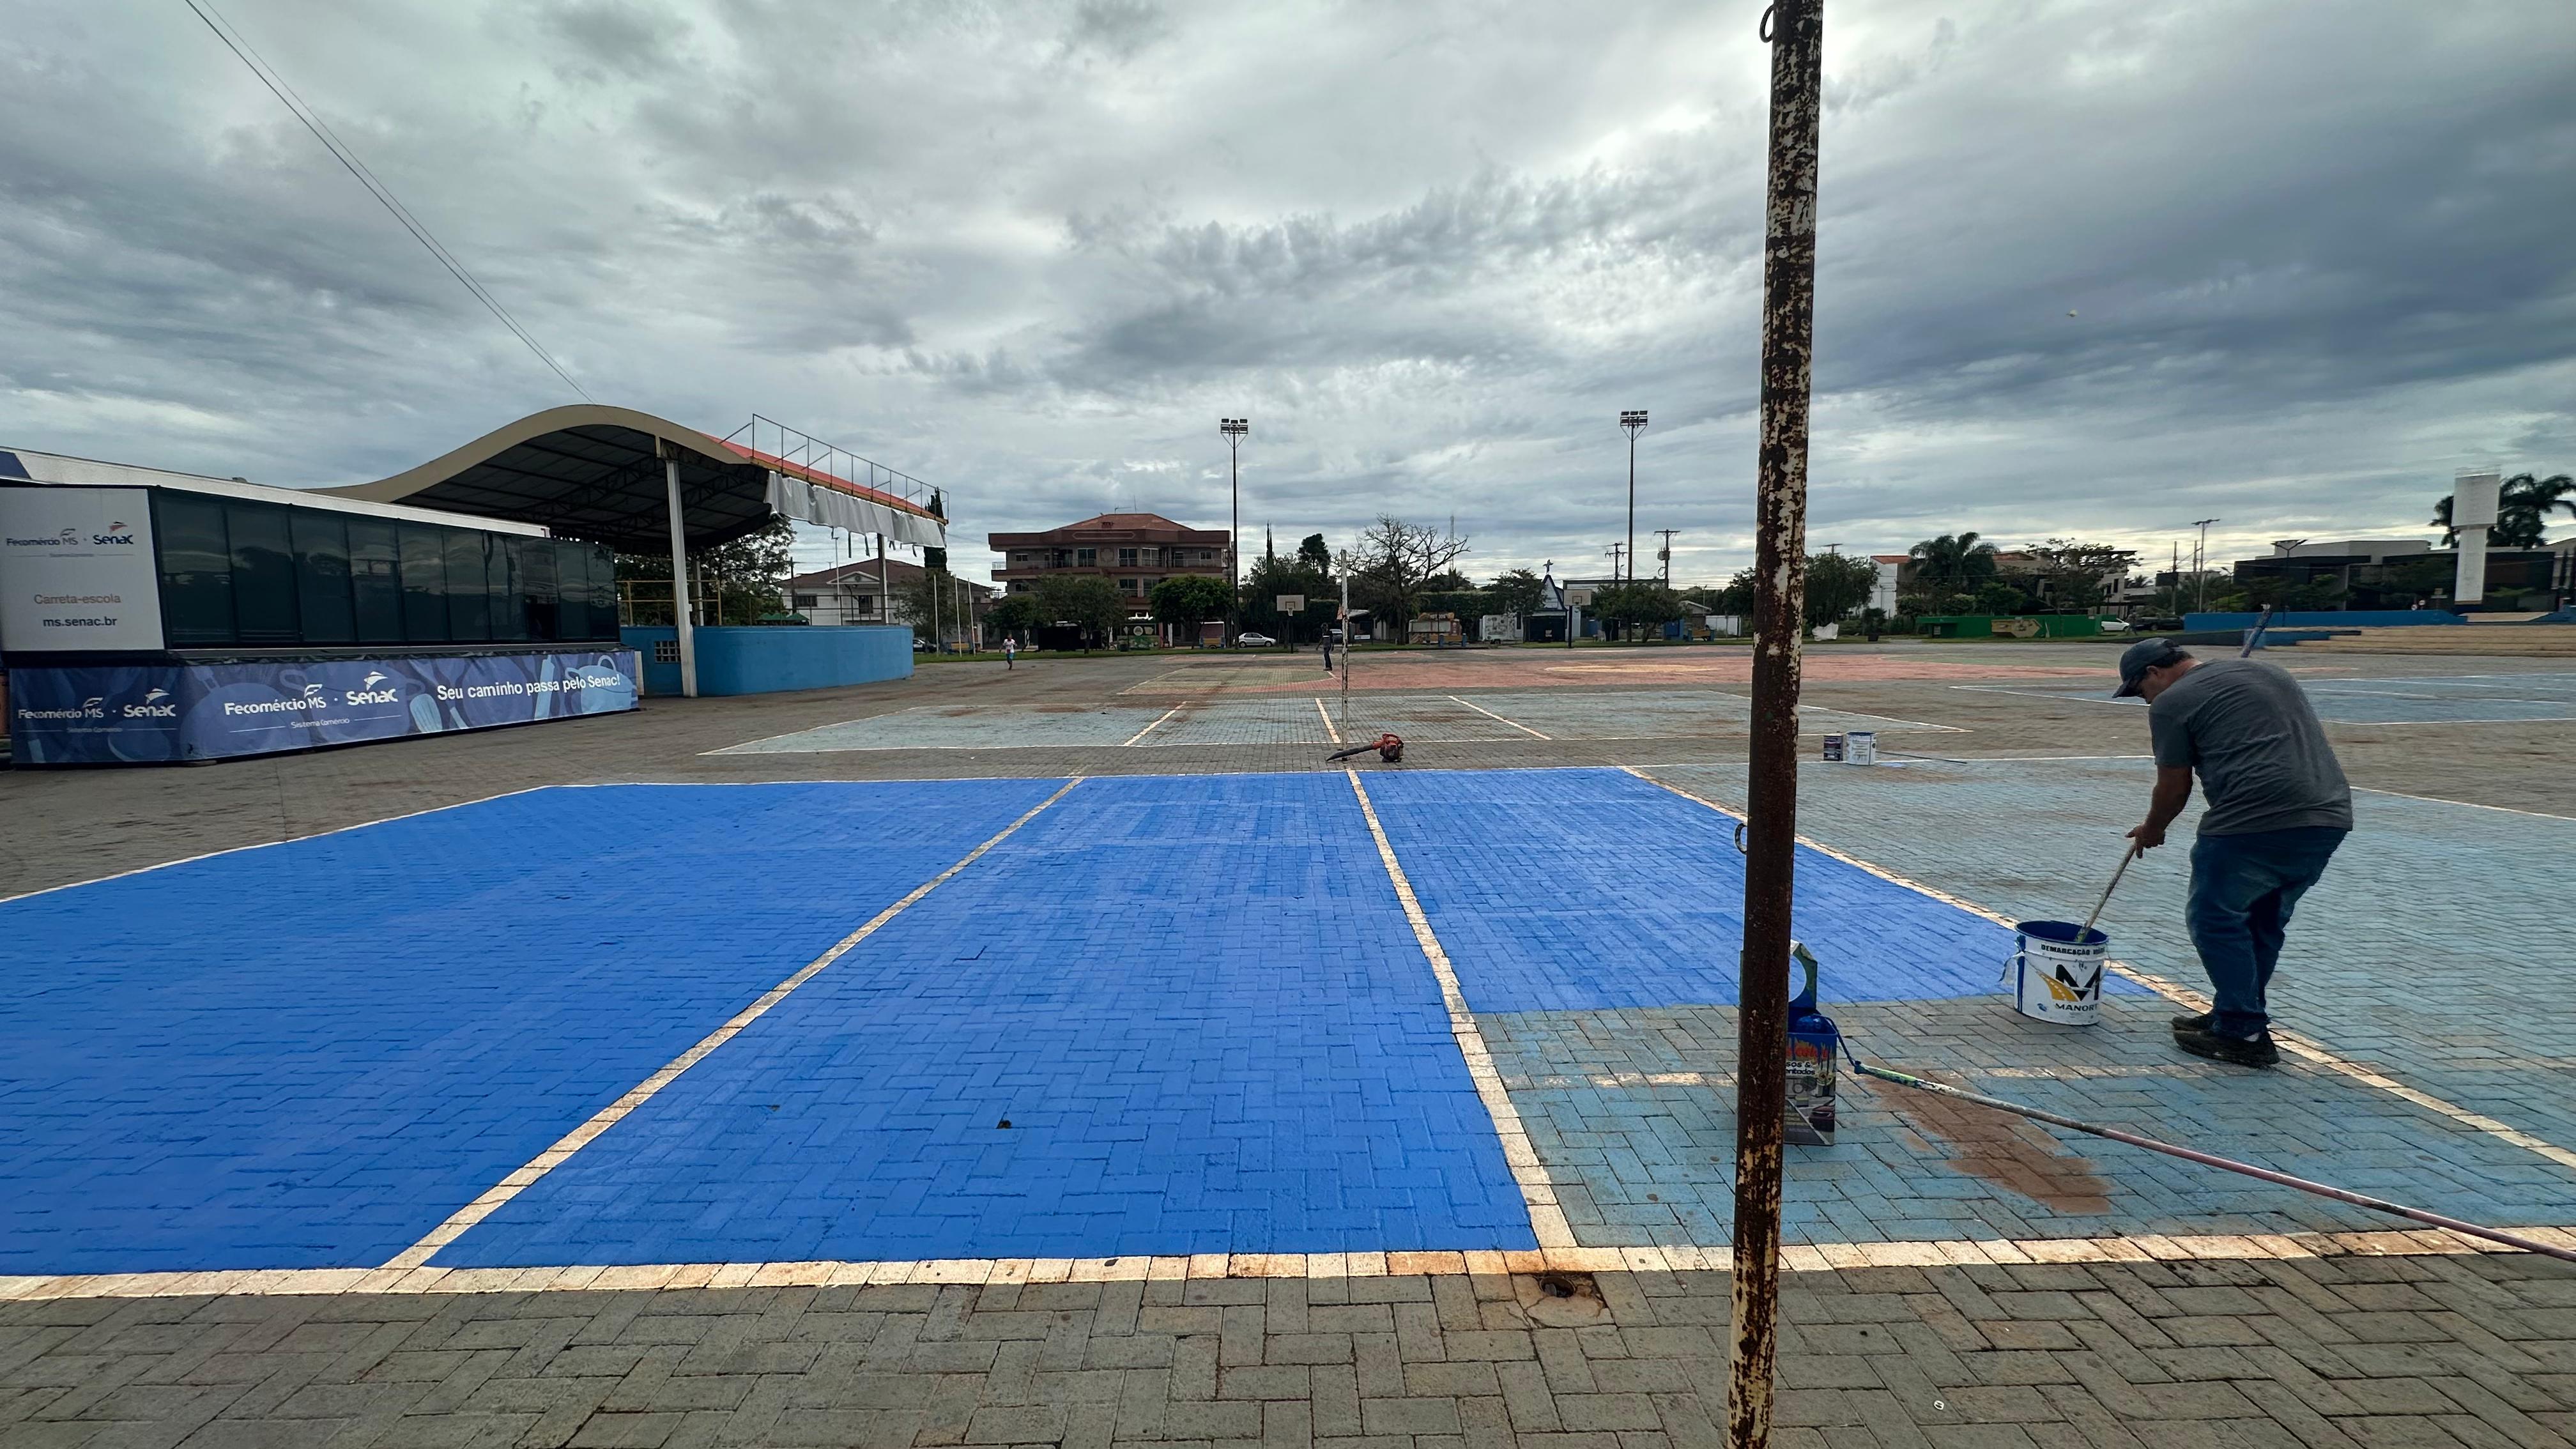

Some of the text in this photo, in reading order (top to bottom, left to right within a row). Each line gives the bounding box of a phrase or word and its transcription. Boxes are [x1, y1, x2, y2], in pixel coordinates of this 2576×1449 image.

[93, 534, 134, 544] Senac
[34, 594, 121, 604] Carreta-escola
[43, 617, 118, 627] ms.senac.br
[437, 674, 620, 701] Seu caminho passa pelo Senac!
[224, 688, 399, 716] Fecomércio MS Senac
[18, 704, 176, 719] Fecomércio MS Senac
[291, 720, 321, 728] Sistema
